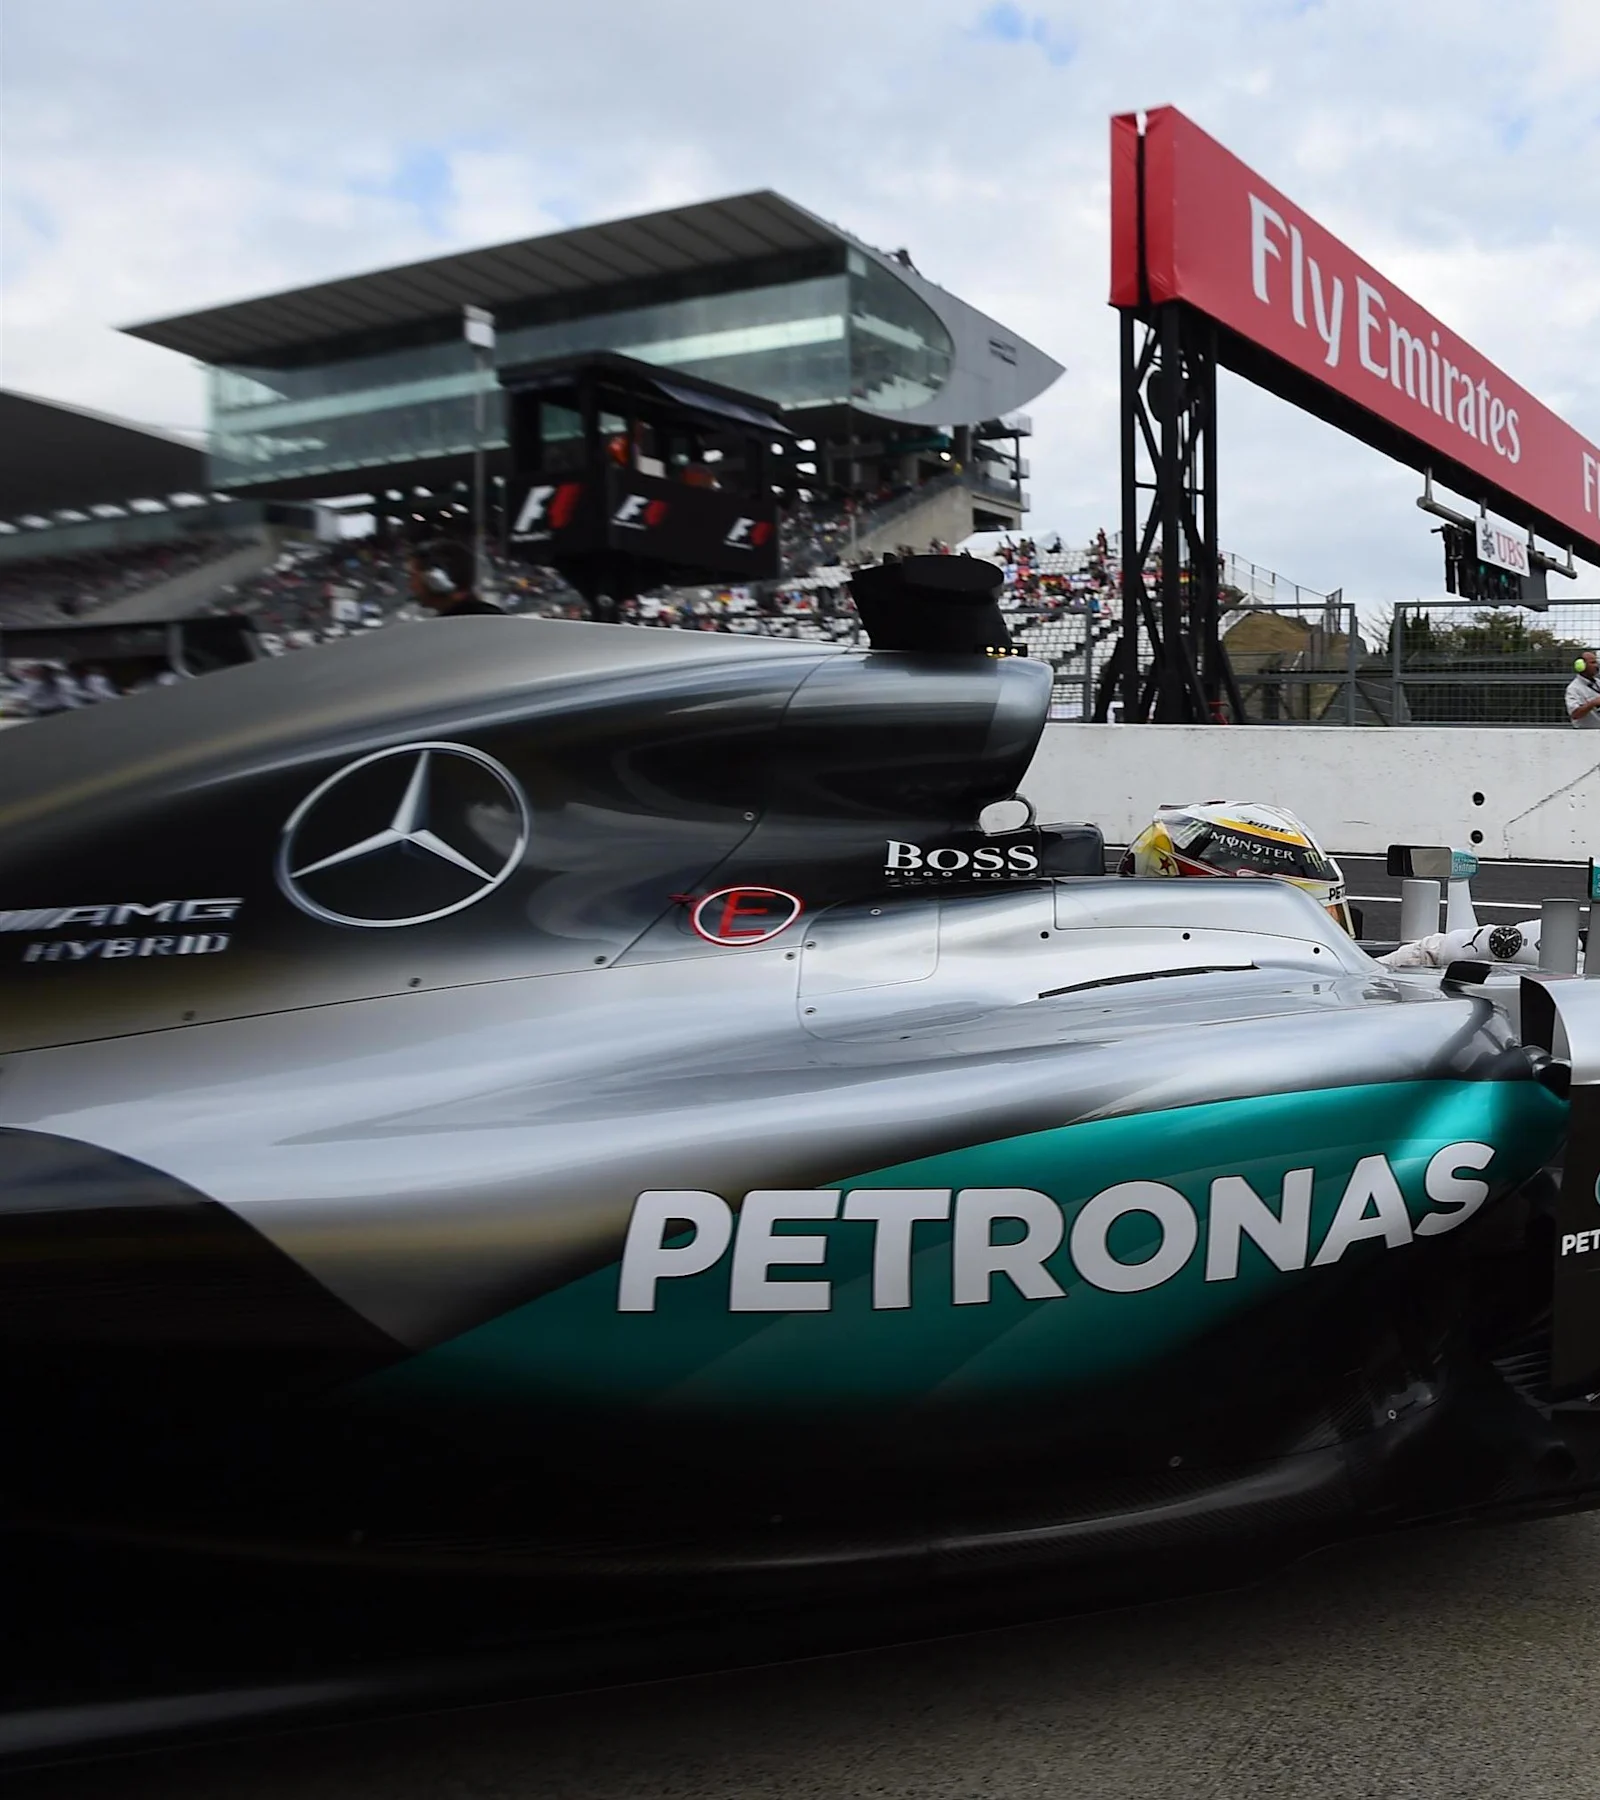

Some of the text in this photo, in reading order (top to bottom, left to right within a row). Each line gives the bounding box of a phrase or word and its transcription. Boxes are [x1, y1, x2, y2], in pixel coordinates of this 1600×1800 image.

[1248, 191, 1520, 464] Fly Emirates
[1495, 529, 1525, 571] UBS
[883, 839, 1039, 871] BOSS
[885, 870, 953, 878] HUGO
[45, 898, 244, 930] AMG
[718, 891, 775, 938] E
[23, 932, 233, 962] HYBRID
[616, 1142, 1496, 1312] PETRONAS
